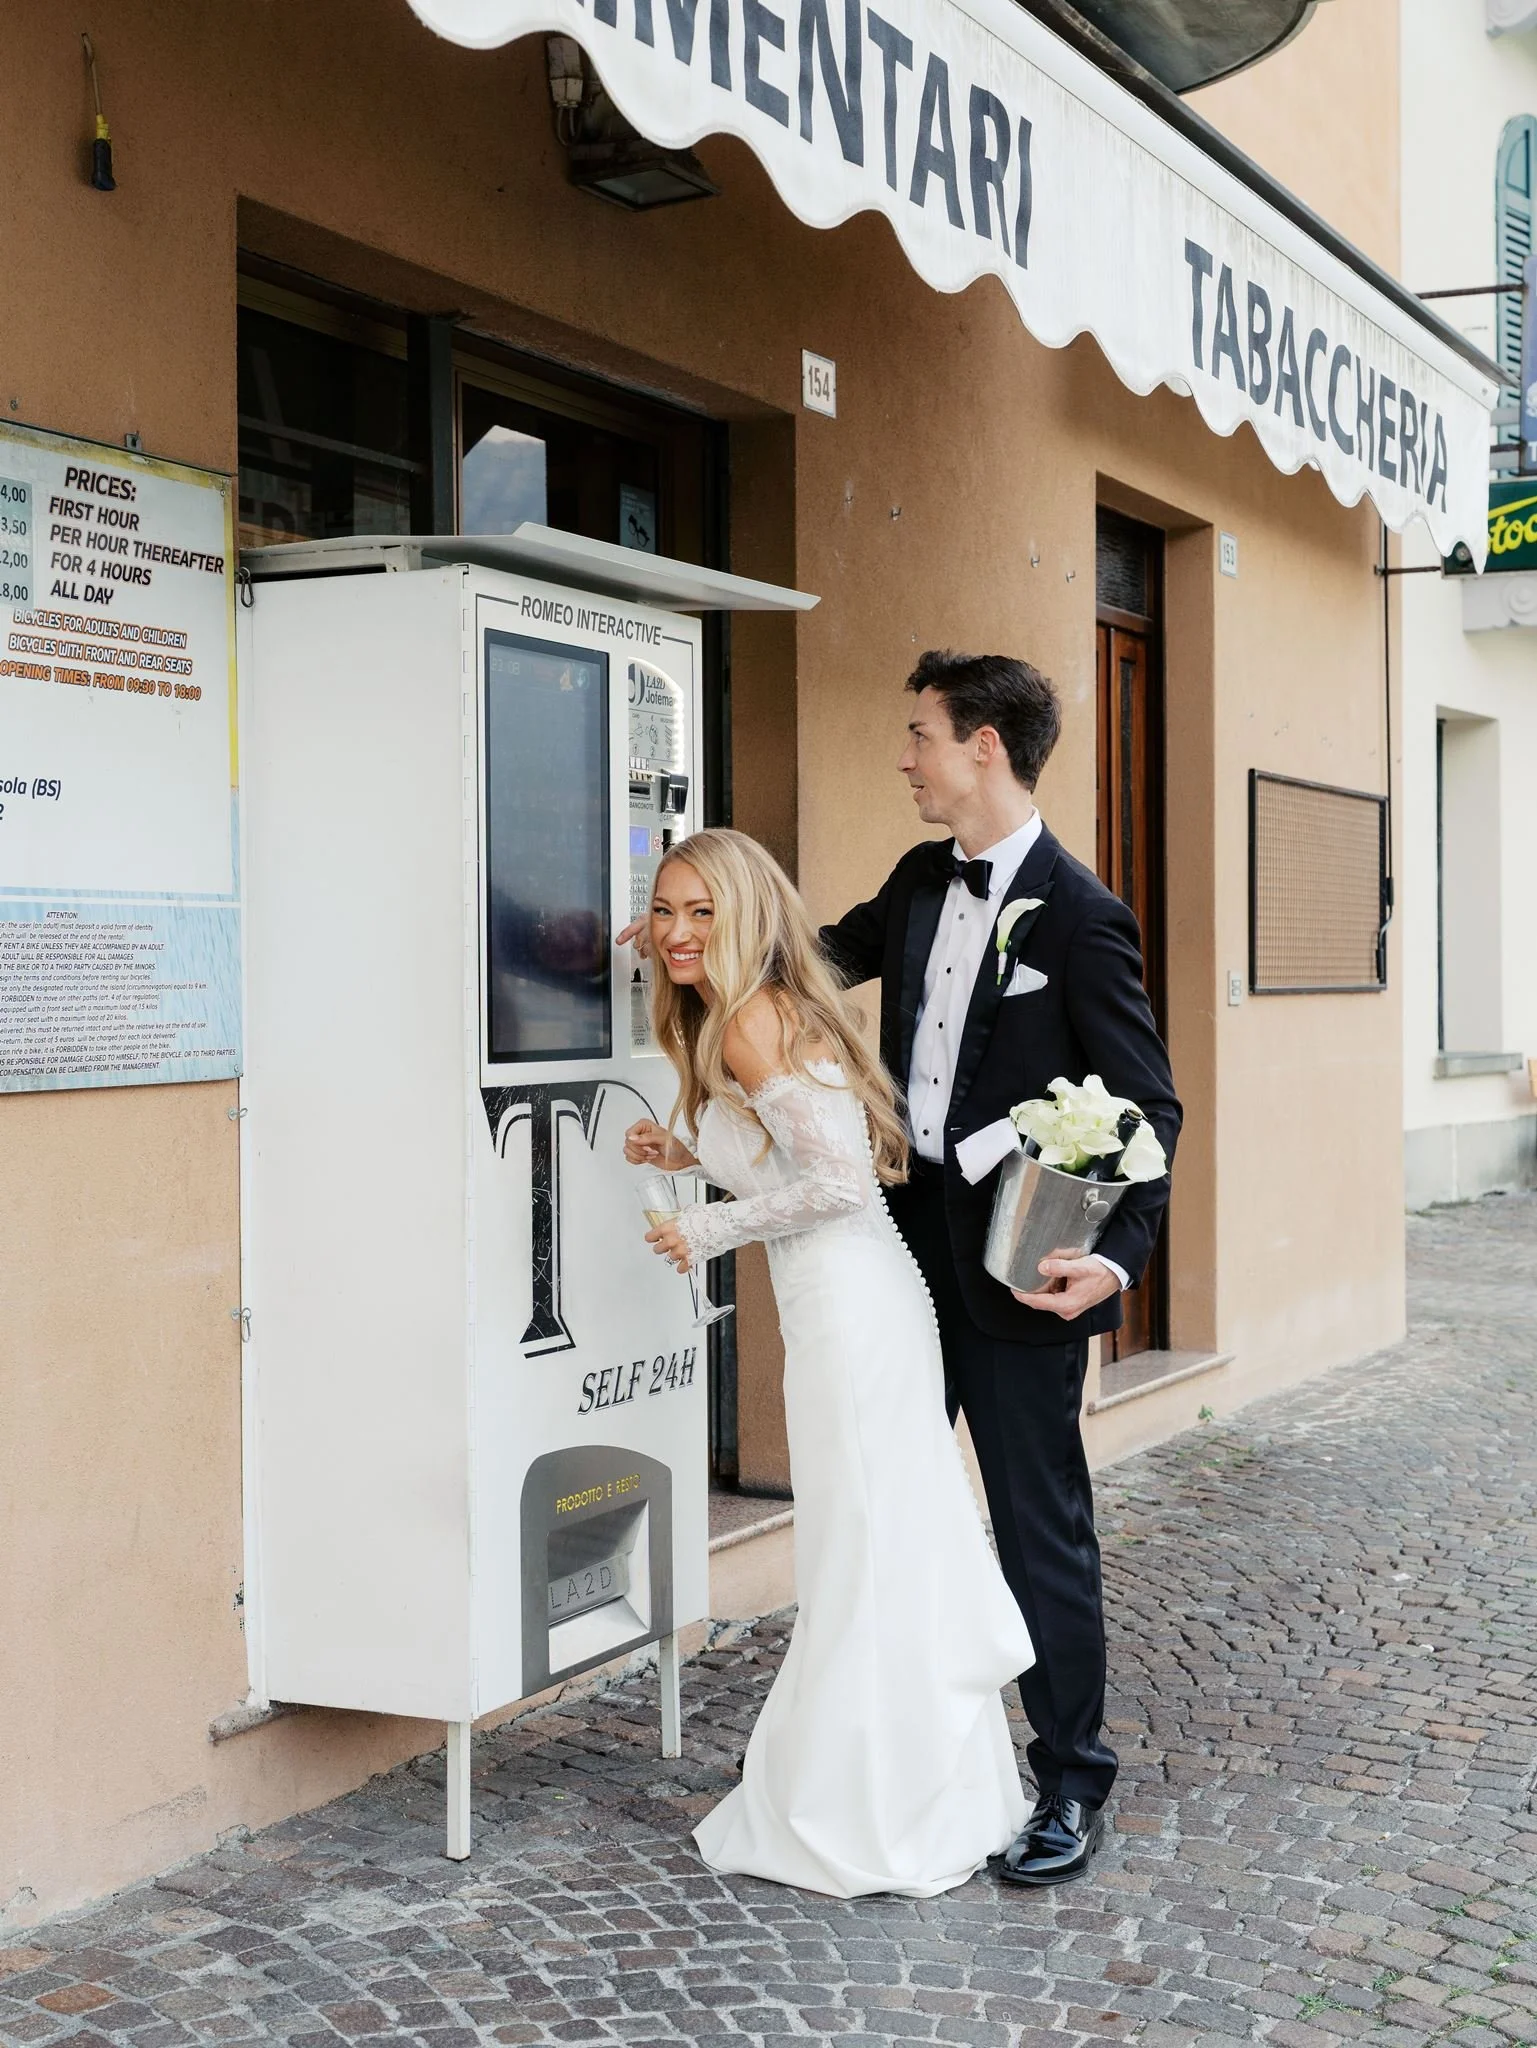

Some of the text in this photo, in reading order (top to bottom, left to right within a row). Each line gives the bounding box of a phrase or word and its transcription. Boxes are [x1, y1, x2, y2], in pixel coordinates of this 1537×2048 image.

[577, 0, 1033, 270] MENTARI
[808, 365, 830, 402] 154
[1184, 236, 1447, 514] TABACCHERIA
[1, 484, 27, 503] 4,00
[64, 466, 137, 502] PRICES:
[1, 516, 27, 536] 3,50
[49, 496, 140, 531] FIRST HOUR
[50, 524, 225, 574] PER HOUR THEREAFTER
[1488, 514, 1537, 556] toc
[0, 549, 28, 569] 2,00
[50, 551, 152, 586] FOR 4 HOURS
[0, 582, 29, 601] 8,00
[50, 580, 114, 605] ALL DAY
[14, 608, 188, 649] BICYCLES FOR ADULTS AND CHILDREN
[520, 595, 662, 646] ROMEO INTERACTIVE
[8, 633, 193, 676] BICYCLES WITH FRONT AND REAR SEATS
[0, 660, 202, 701] OPENING TIMES: FROM 09:30 TO 18:00
[31, 778, 62, 800] (BS)
[3, 963, 17, 971] THE
[16, 963, 30, 971] BIKE
[1, 994, 34, 1002] FORBIDDEN
[7, 1056, 46, 1065] RESPONSIBLE
[60, 1055, 84, 1063] DAMAGE
[85, 1054, 107, 1062] CAUSED
[201, 1049, 215, 1057] THIRD
[55, 1045, 88, 1053] FORBIDDEN
[67, 1064, 93, 1073] CLAIMED
[93, 1063, 110, 1072] FROM
[577, 1346, 697, 1416] SELF 24H
[556, 1473, 641, 1515] PRODOTTO E RESTO
[550, 1565, 612, 1610] LA2D
